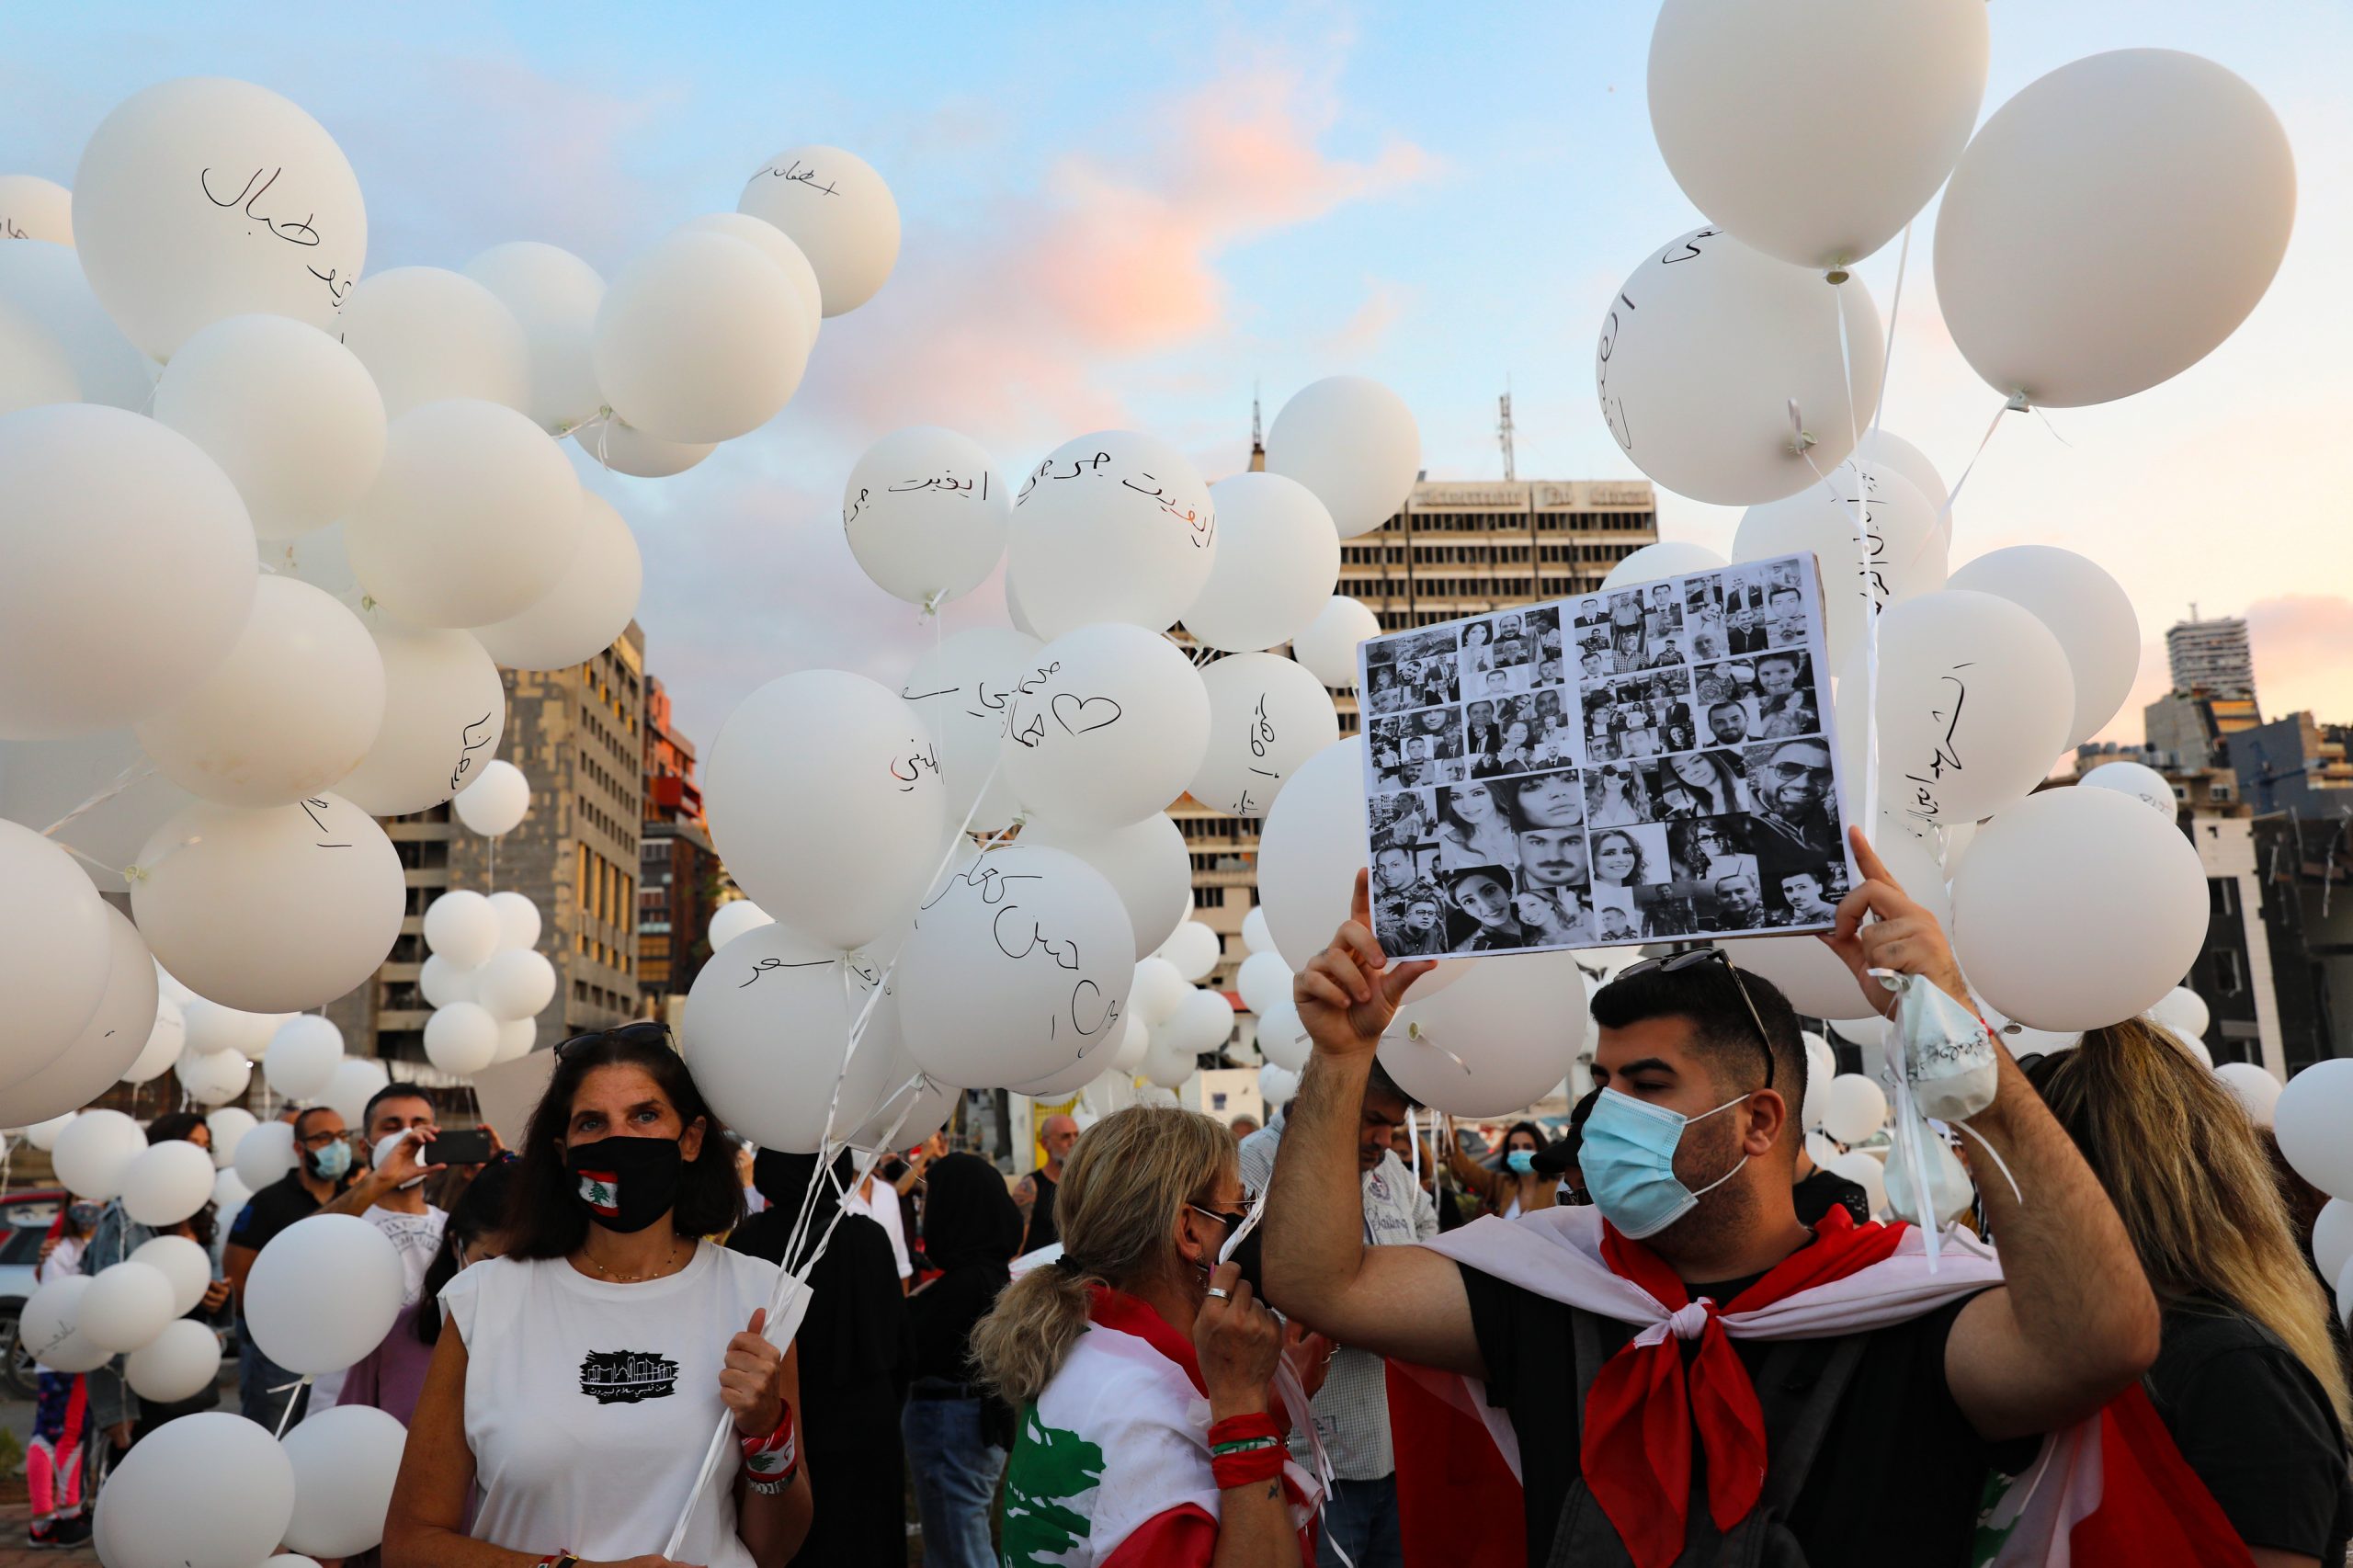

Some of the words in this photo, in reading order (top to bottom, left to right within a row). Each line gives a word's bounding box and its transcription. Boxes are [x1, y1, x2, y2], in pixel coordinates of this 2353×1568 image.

[1930, 662, 1976, 779] الشهيد
[590, 1387, 615, 1396] لبيروت
[616, 1387, 634, 1396] سلام
[635, 1383, 654, 1397] قلبي
